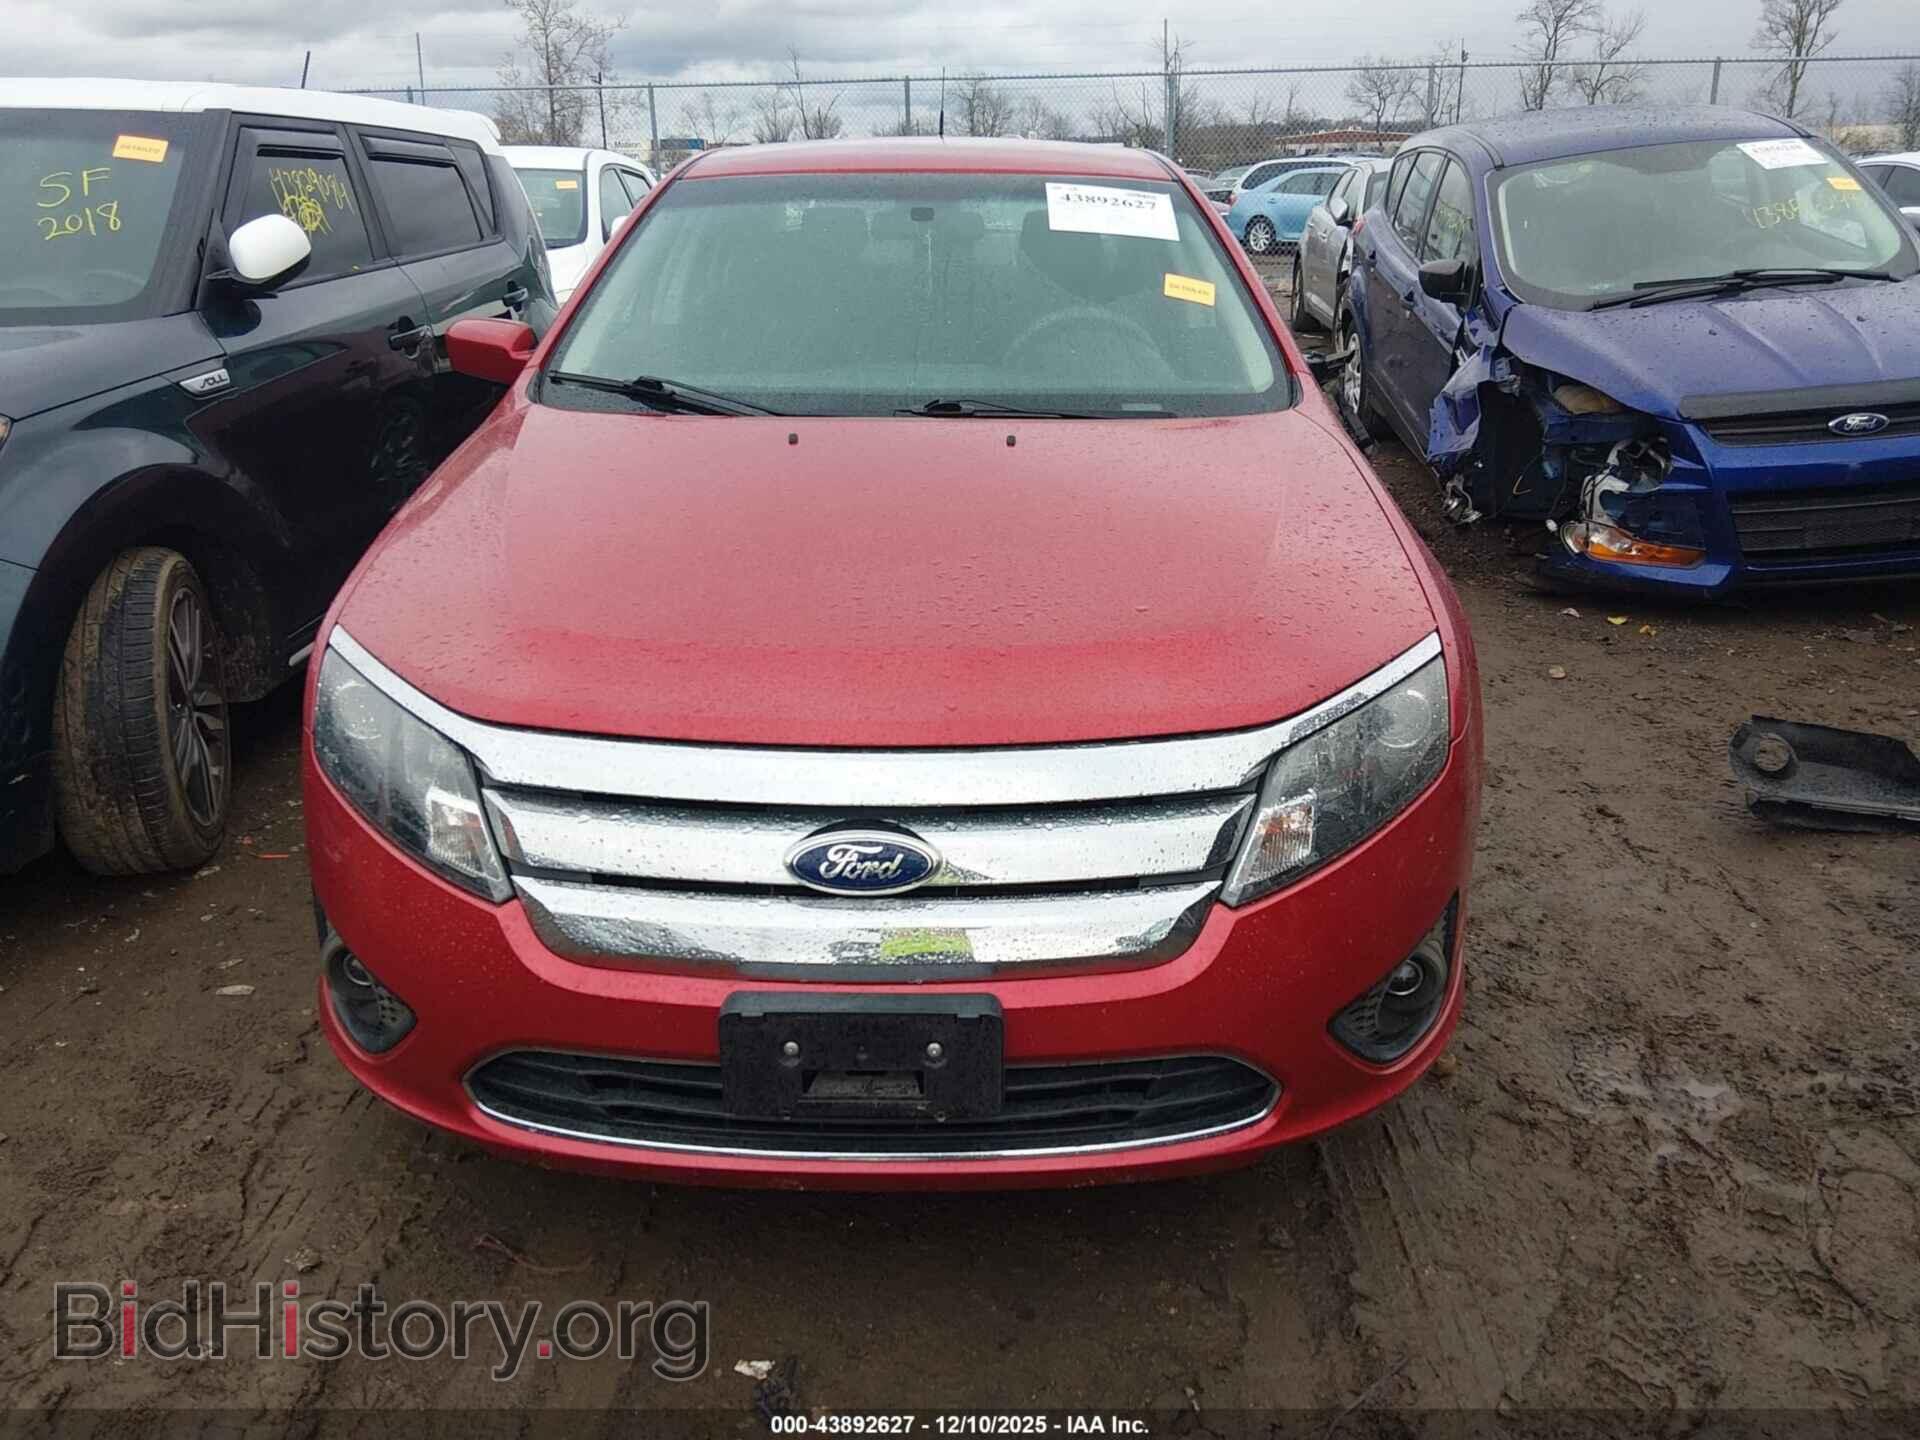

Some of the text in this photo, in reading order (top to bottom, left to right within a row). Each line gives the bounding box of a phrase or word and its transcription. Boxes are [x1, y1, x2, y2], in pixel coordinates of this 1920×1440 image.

[1059, 193, 1157, 210] 43892627
[36, 199, 122, 241] 2018
[1844, 415, 1878, 431] Ford
[818, 843, 905, 880] Ford
